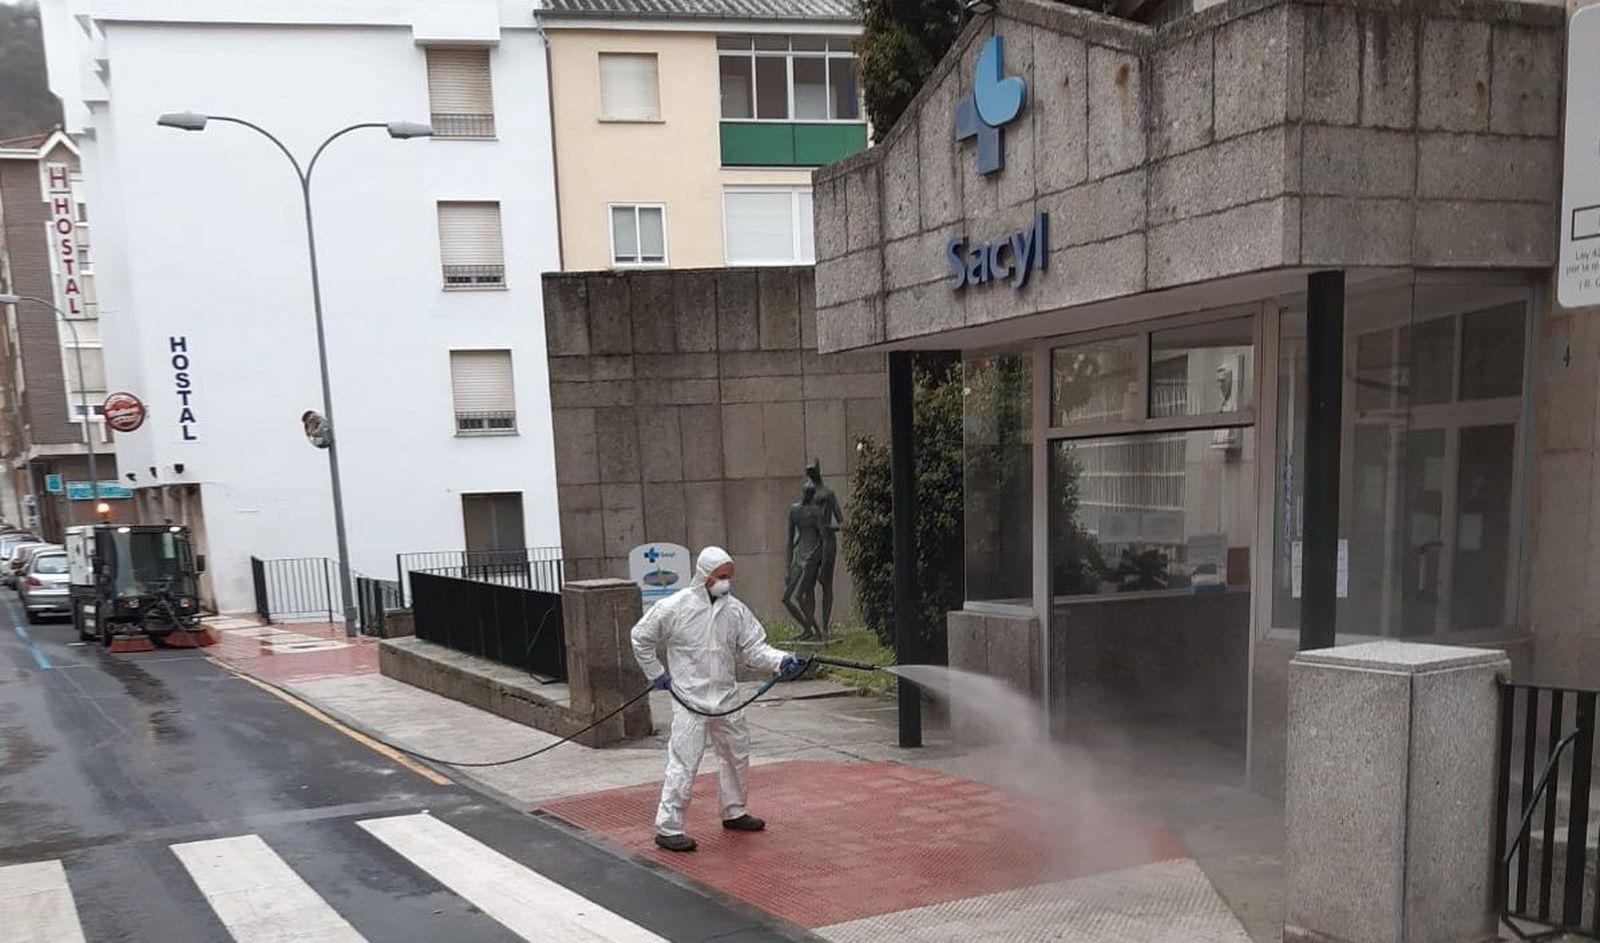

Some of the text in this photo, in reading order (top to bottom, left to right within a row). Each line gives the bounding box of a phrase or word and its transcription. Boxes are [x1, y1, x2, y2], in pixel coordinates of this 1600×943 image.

[54, 197, 81, 315] HOSTAL
[946, 211, 1050, 292] Sacyl
[169, 336, 197, 441] HOSTAL
